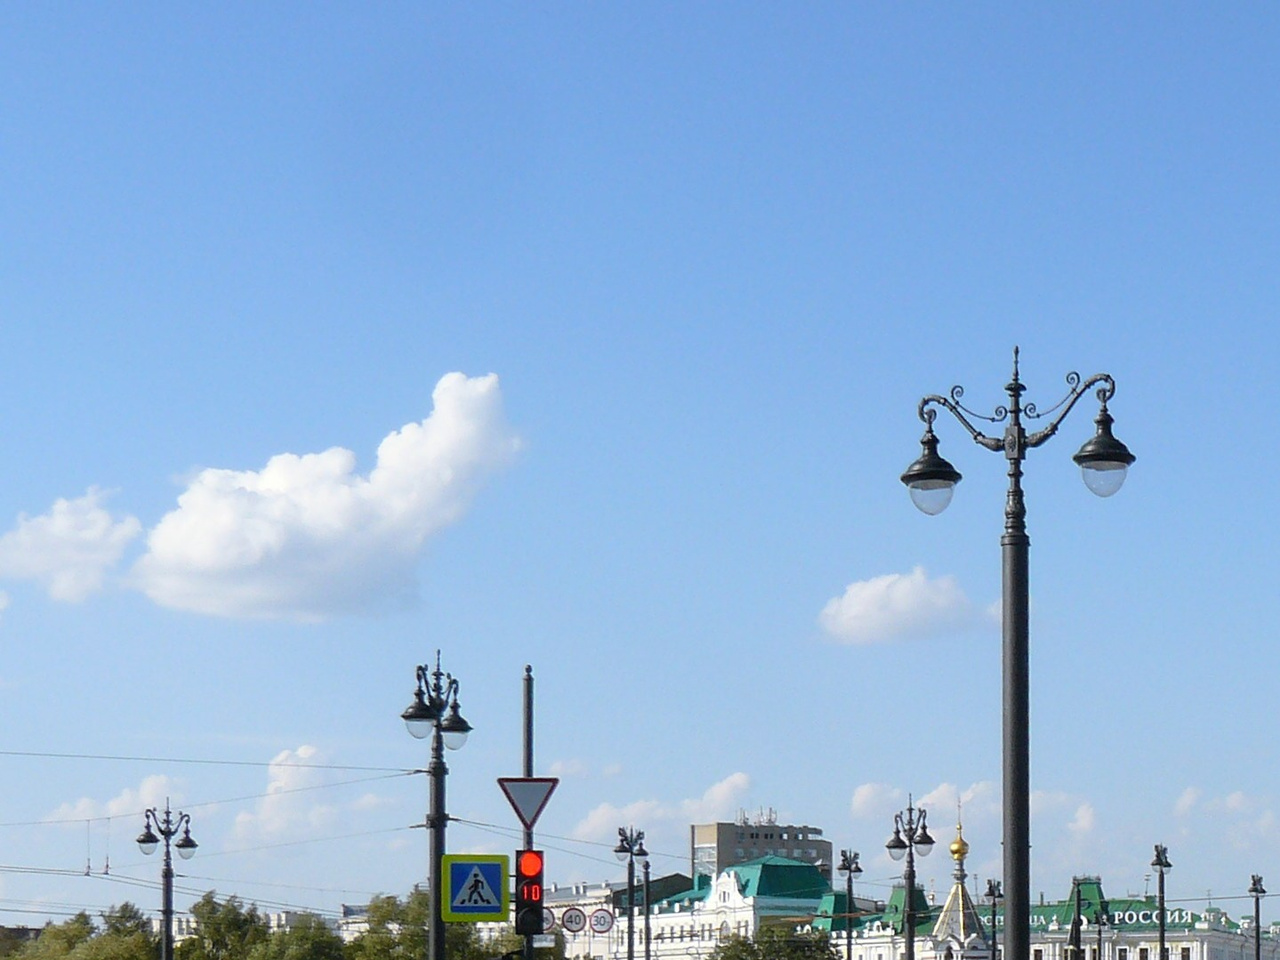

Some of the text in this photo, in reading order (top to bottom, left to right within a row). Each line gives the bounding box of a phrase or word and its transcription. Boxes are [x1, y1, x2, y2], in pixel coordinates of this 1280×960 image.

[523, 884, 540, 901] 10
[566, 914, 581, 925] 40
[1114, 910, 1193, 924] РОССИЯ
